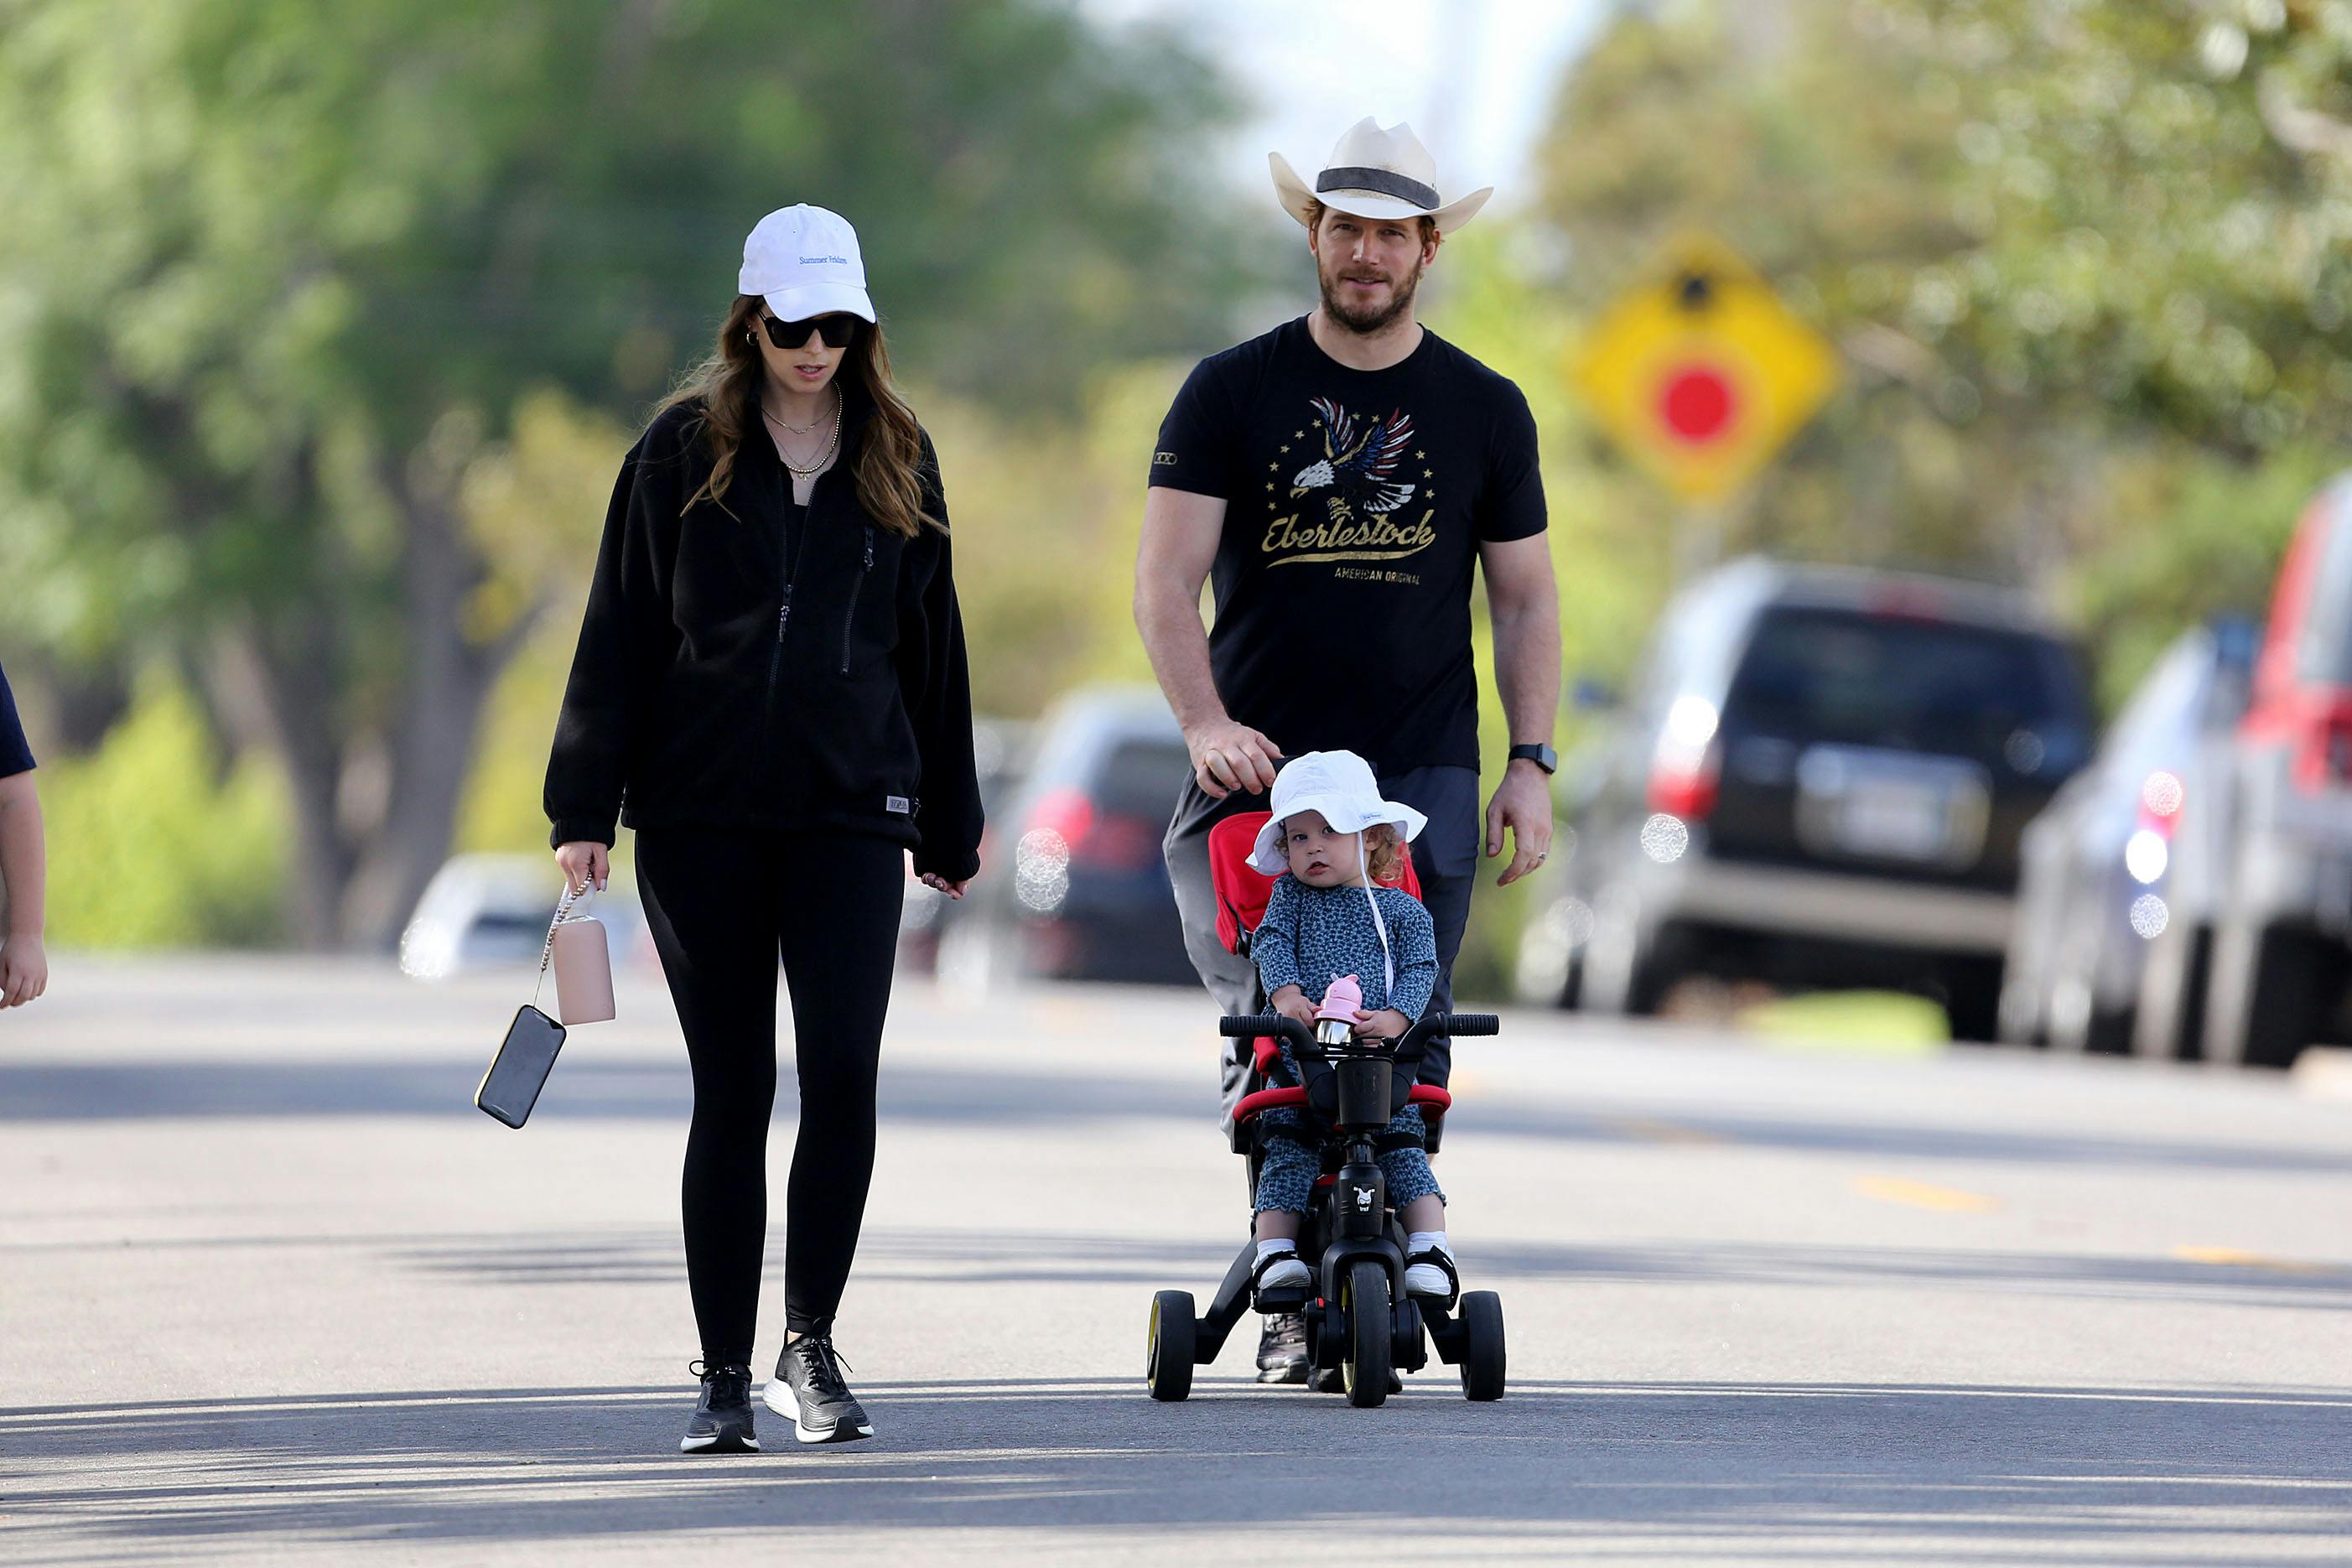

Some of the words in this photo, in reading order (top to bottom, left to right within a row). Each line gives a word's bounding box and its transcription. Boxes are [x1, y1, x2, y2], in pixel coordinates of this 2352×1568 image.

[799, 256, 828, 264] Summer
[1261, 509, 1436, 552] Eberlestock
[1335, 567, 1383, 581] AMERICAN
[1385, 571, 1420, 585] ORIGINAL
